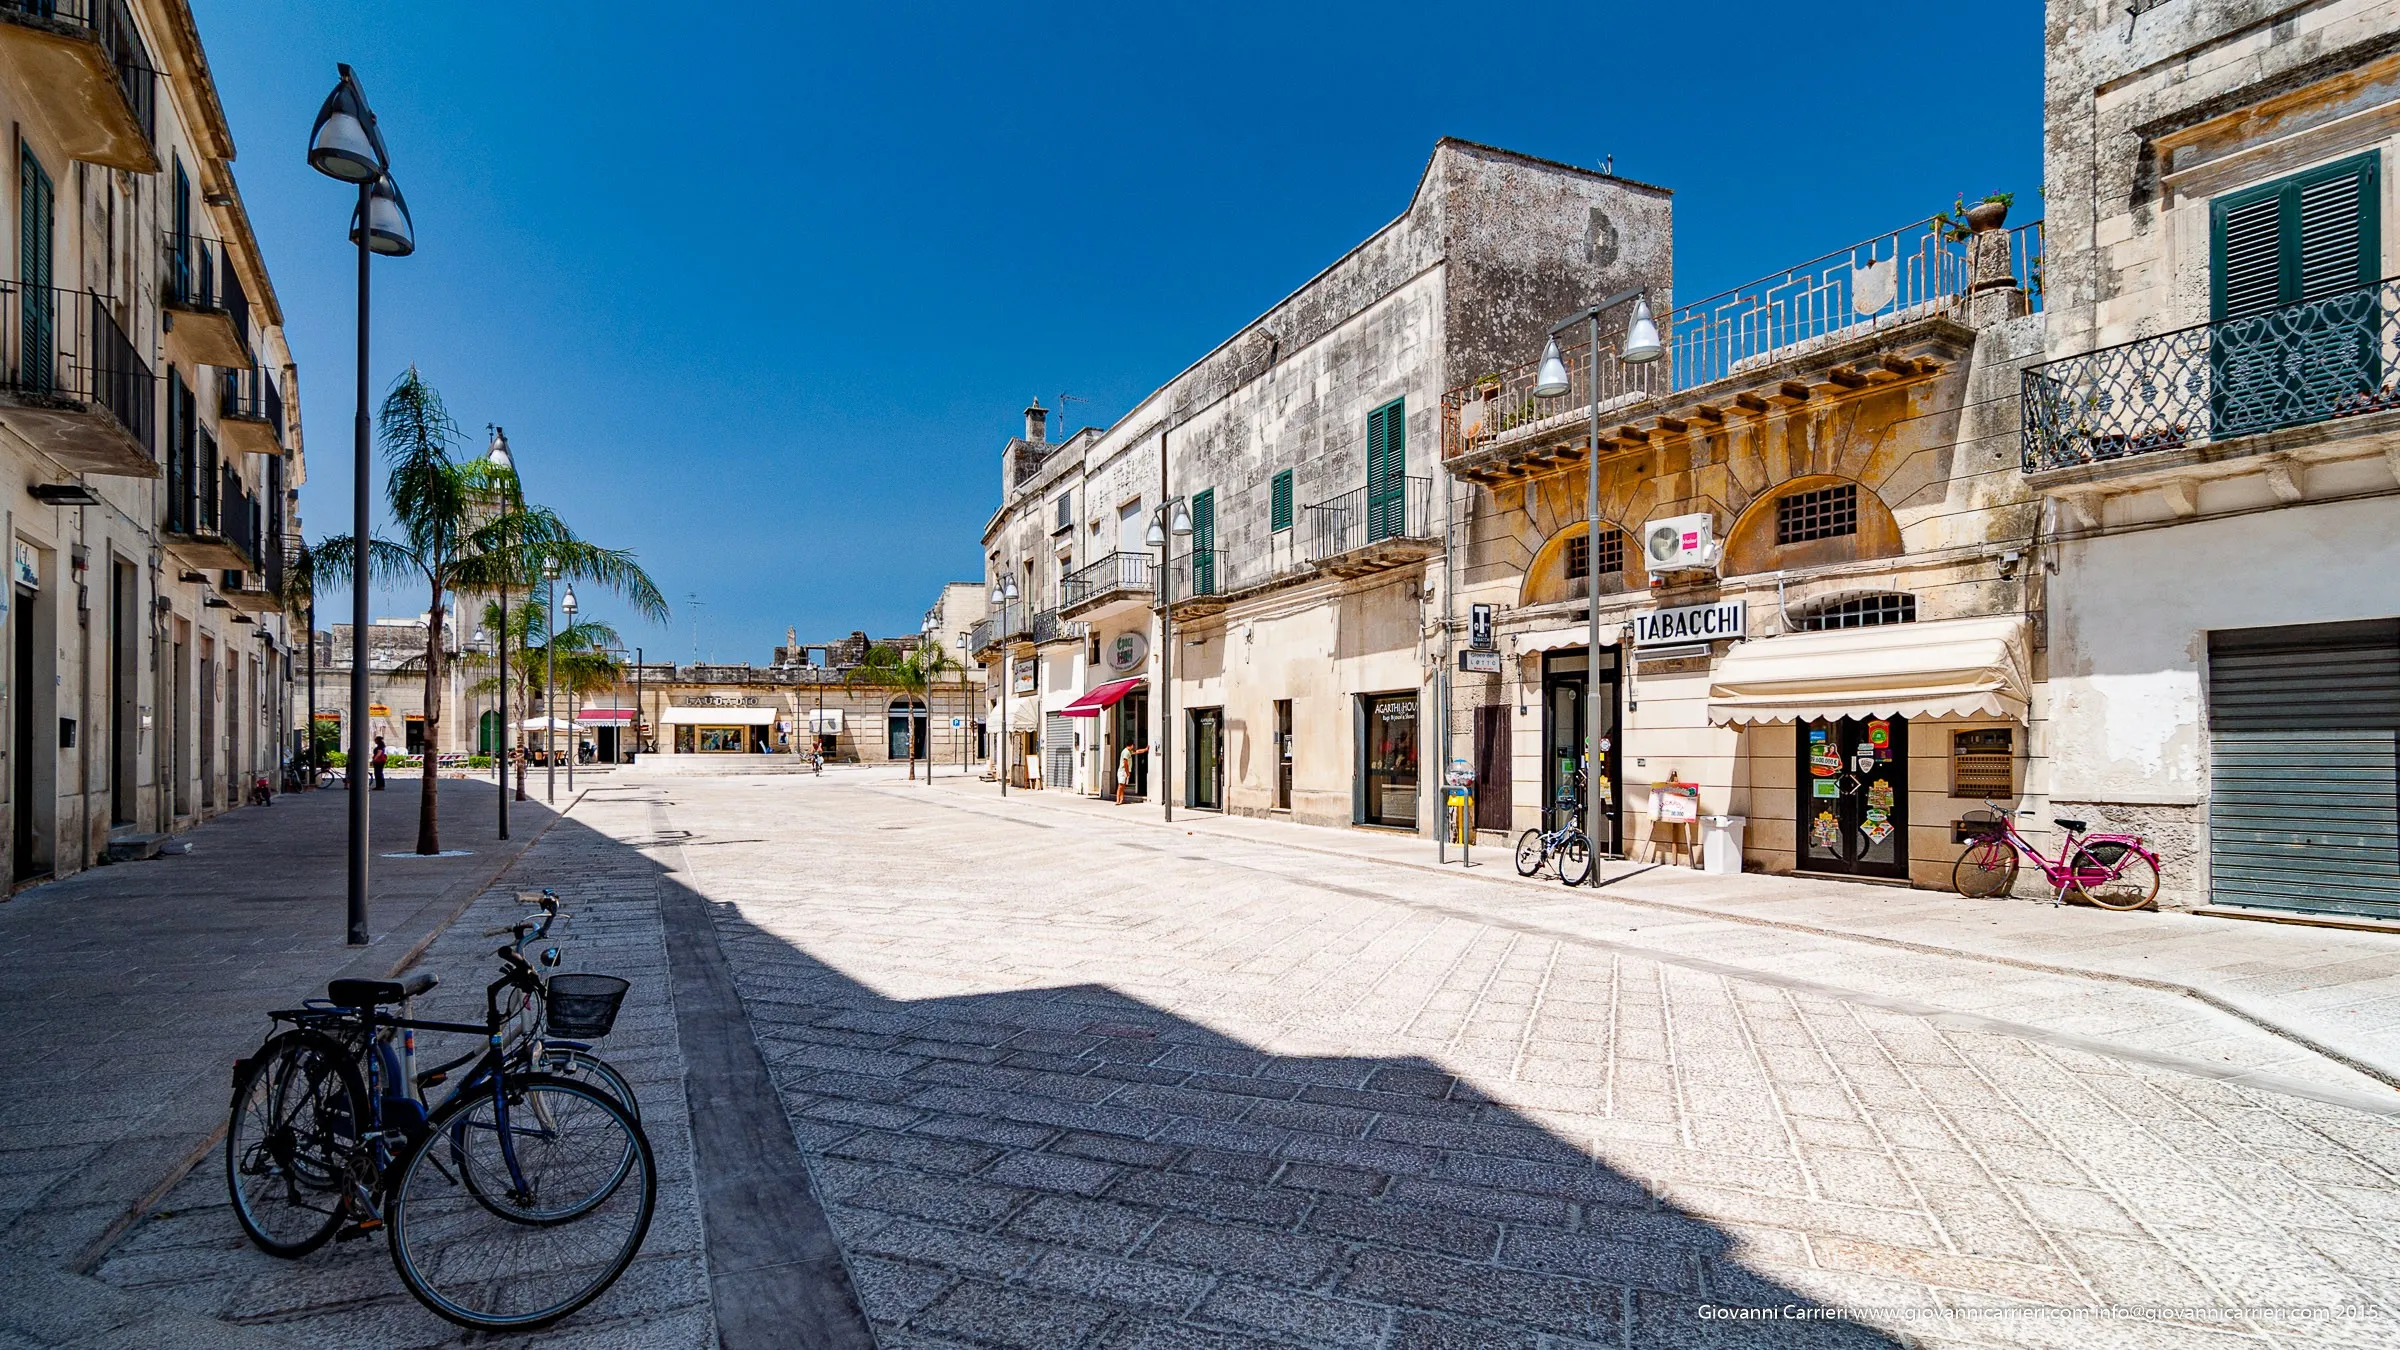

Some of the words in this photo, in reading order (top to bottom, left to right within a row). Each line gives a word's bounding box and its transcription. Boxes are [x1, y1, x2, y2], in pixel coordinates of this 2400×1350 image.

[1475, 606, 1489, 634] T
[1637, 606, 1738, 640] TABACCHI
[686, 697, 758, 706] LAUDADIO
[1375, 703, 1401, 714] AGARTHI
